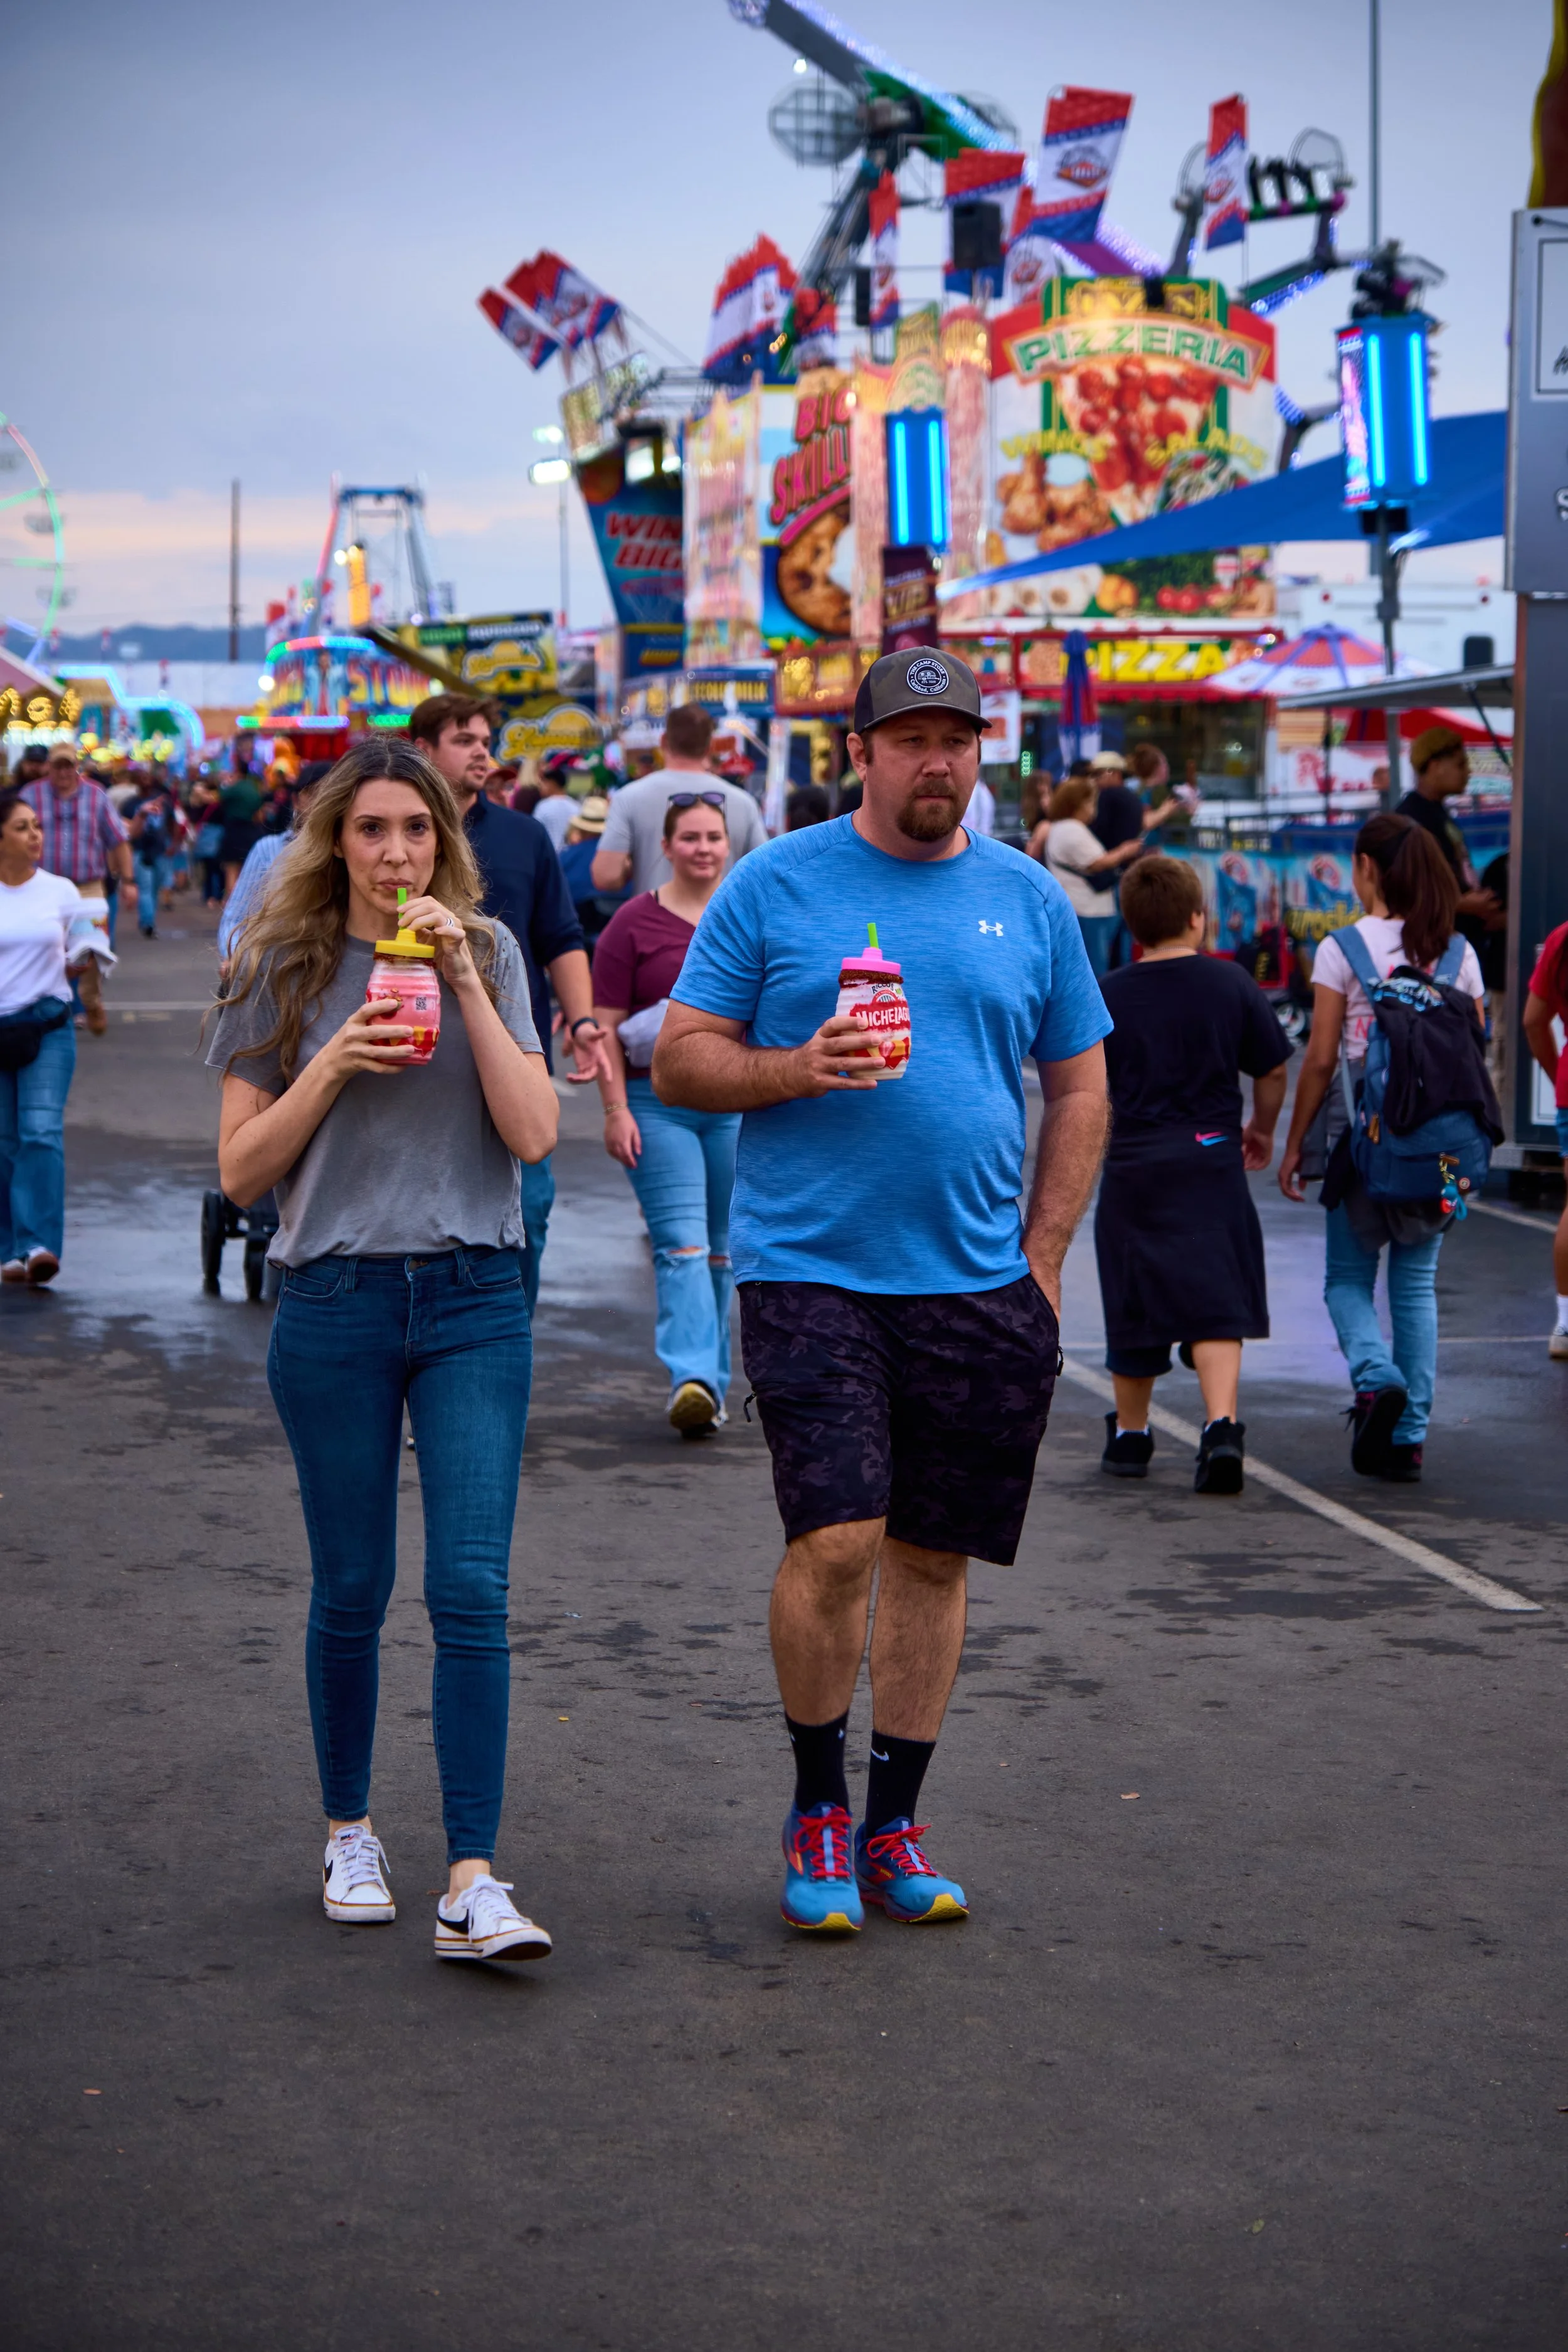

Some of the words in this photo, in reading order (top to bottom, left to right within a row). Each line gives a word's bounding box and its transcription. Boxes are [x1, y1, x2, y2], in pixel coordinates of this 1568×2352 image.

[1015, 324, 1249, 378] PIZZERIA
[769, 425, 852, 526] SKILL
[931, 662, 945, 674] STORE
[911, 679, 928, 693] Carlsbad,
[930, 679, 946, 692] California
